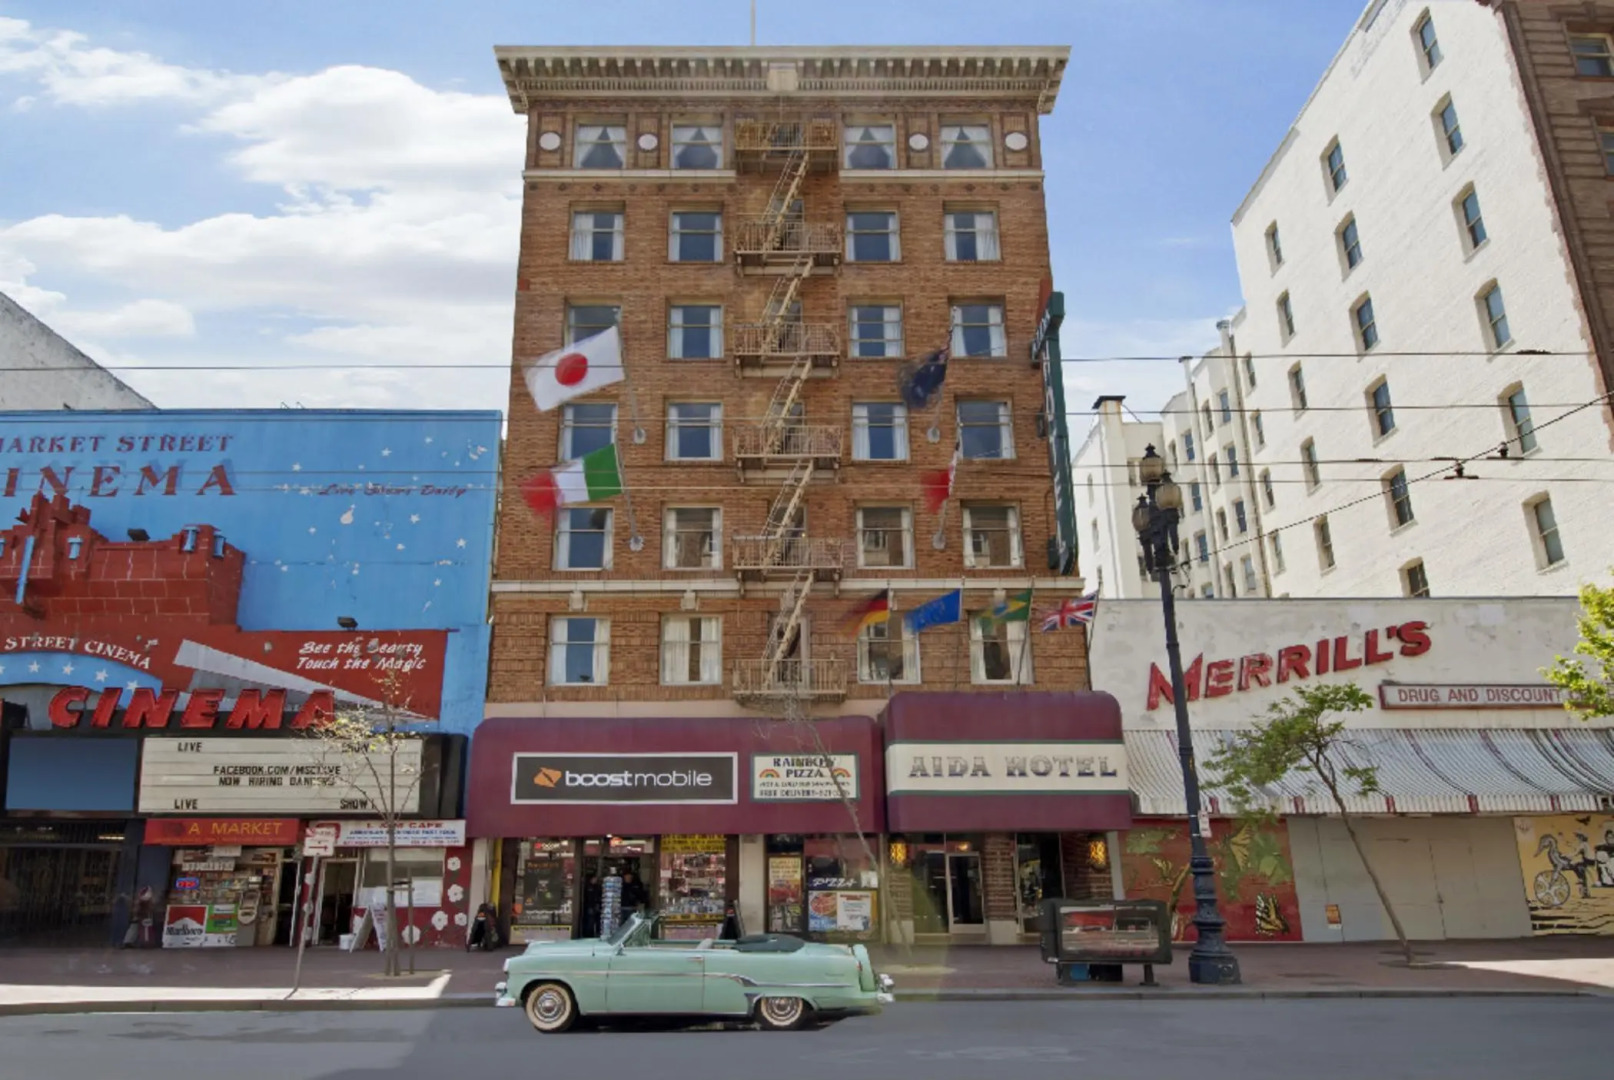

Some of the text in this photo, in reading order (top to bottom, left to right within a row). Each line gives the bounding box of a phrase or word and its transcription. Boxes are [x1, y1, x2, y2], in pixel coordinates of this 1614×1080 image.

[116, 434, 234, 453] STREET
[4, 636, 151, 670] STREET CINEMA
[337, 640, 361, 655] the
[296, 657, 427, 673] Touch the Magic
[1146, 620, 1433, 711] MERRILL'S
[1397, 688, 1441, 702] DRUG
[1448, 688, 1479, 702] AND
[1486, 687, 1562, 702] DISCOUNT
[48, 686, 336, 729] CINEMA
[177, 741, 202, 753] LIVE
[908, 755, 1118, 777] AIDA HOTEL
[219, 776, 240, 786] NOW
[248, 776, 283, 786] HIRING
[786, 769, 824, 779] PIZZA
[174, 798, 198, 810] LIVE
[188, 822, 283, 835] A MARKET
